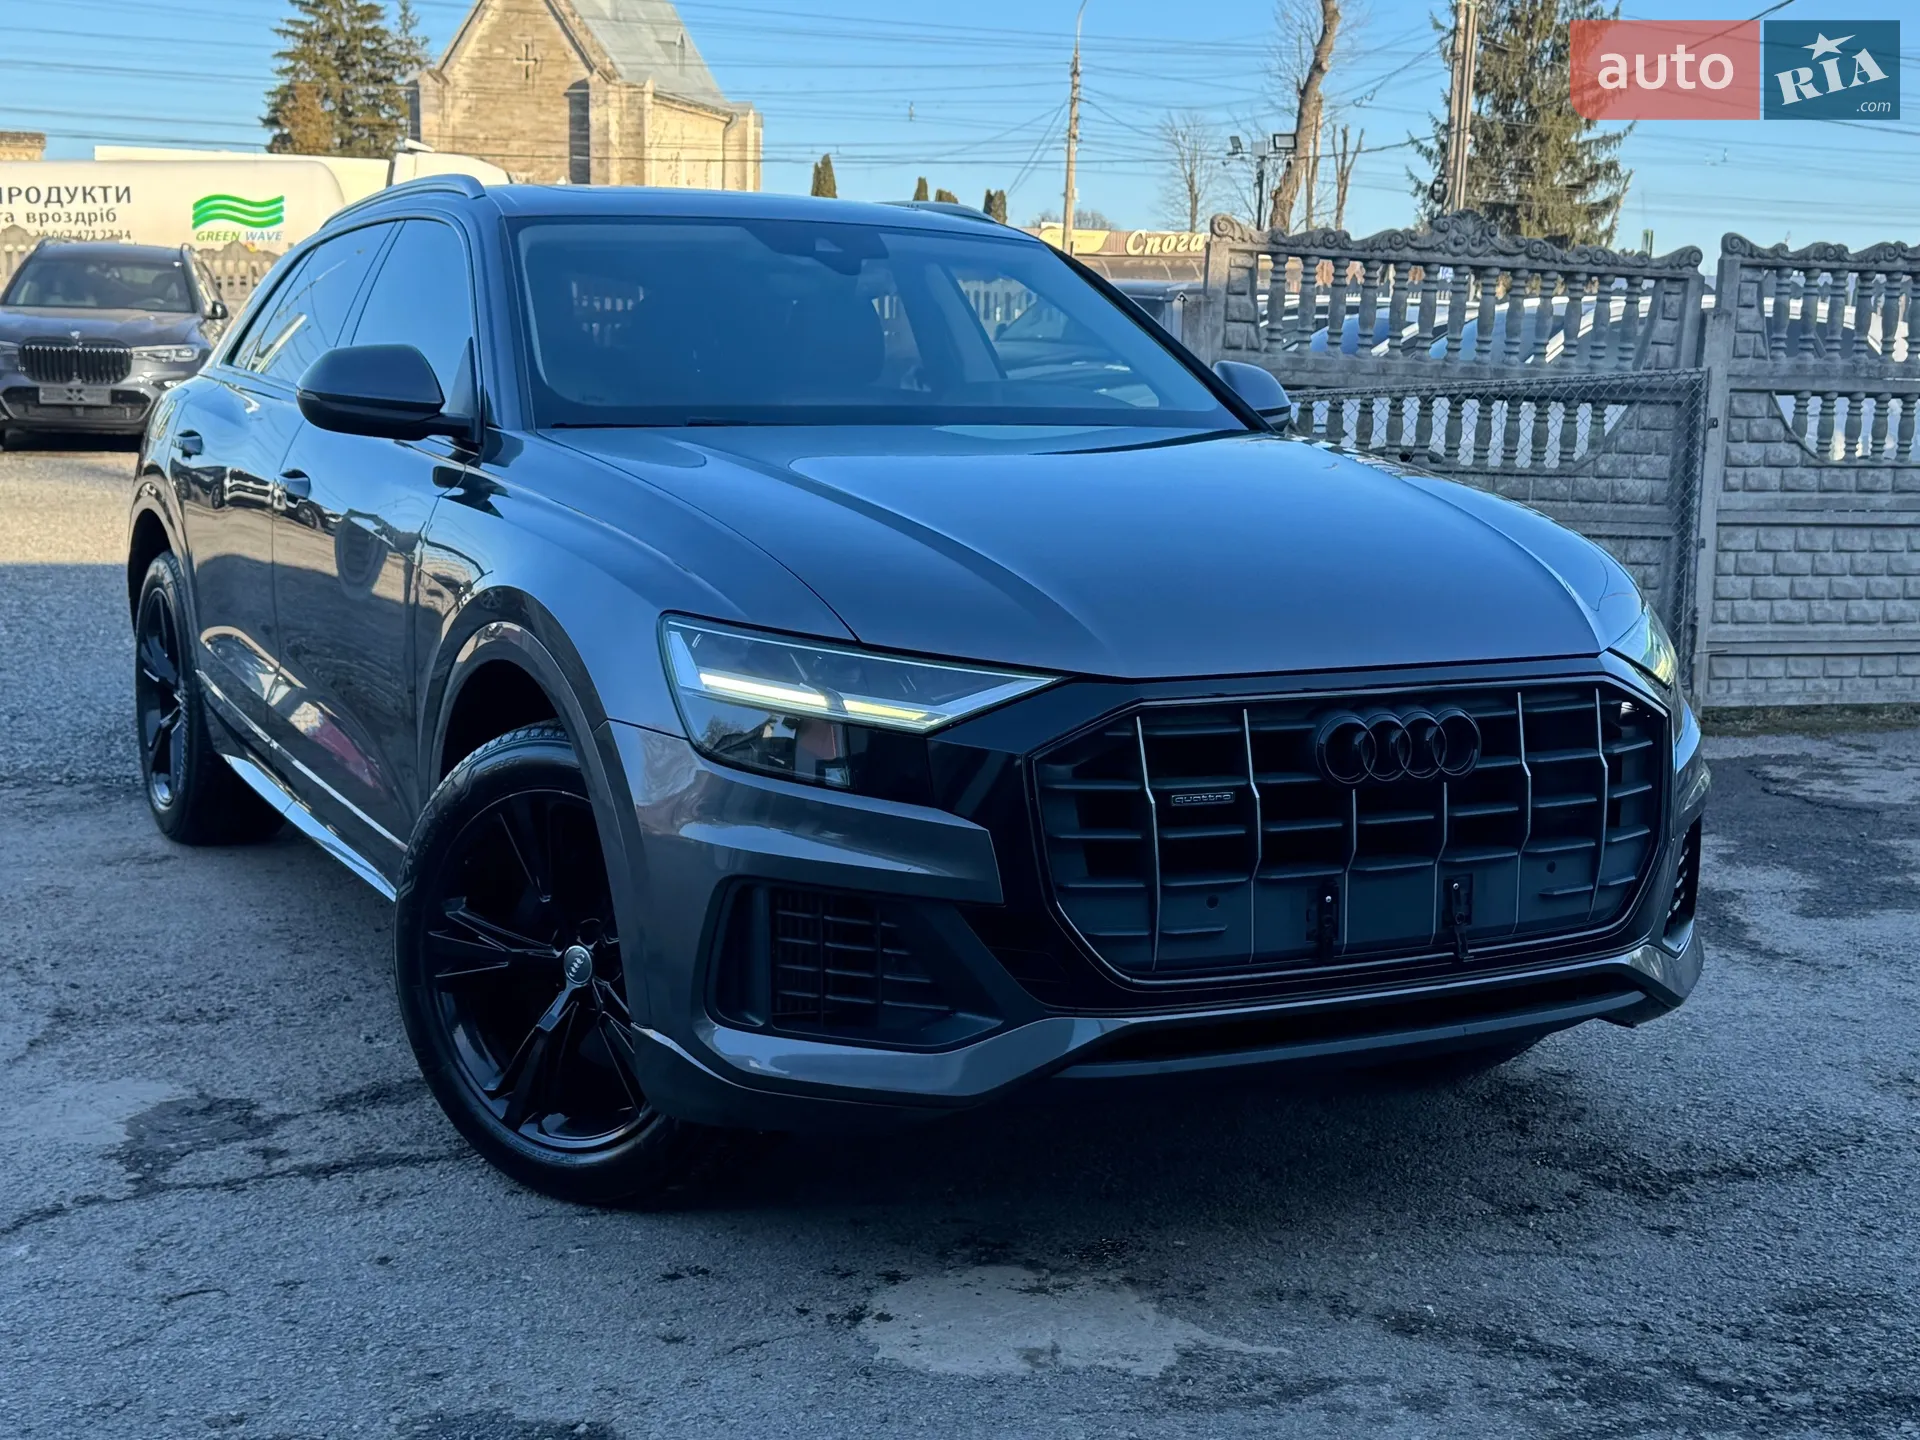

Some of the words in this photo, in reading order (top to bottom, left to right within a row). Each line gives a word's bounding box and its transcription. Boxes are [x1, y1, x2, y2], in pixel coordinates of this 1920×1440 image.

[0, 186, 131, 208] РОДУКТИ
[26, 207, 117, 227] вроздріб
[195, 230, 241, 242] GREEN
[245, 230, 284, 242] WAVE
[1174, 793, 1232, 804] quattro
